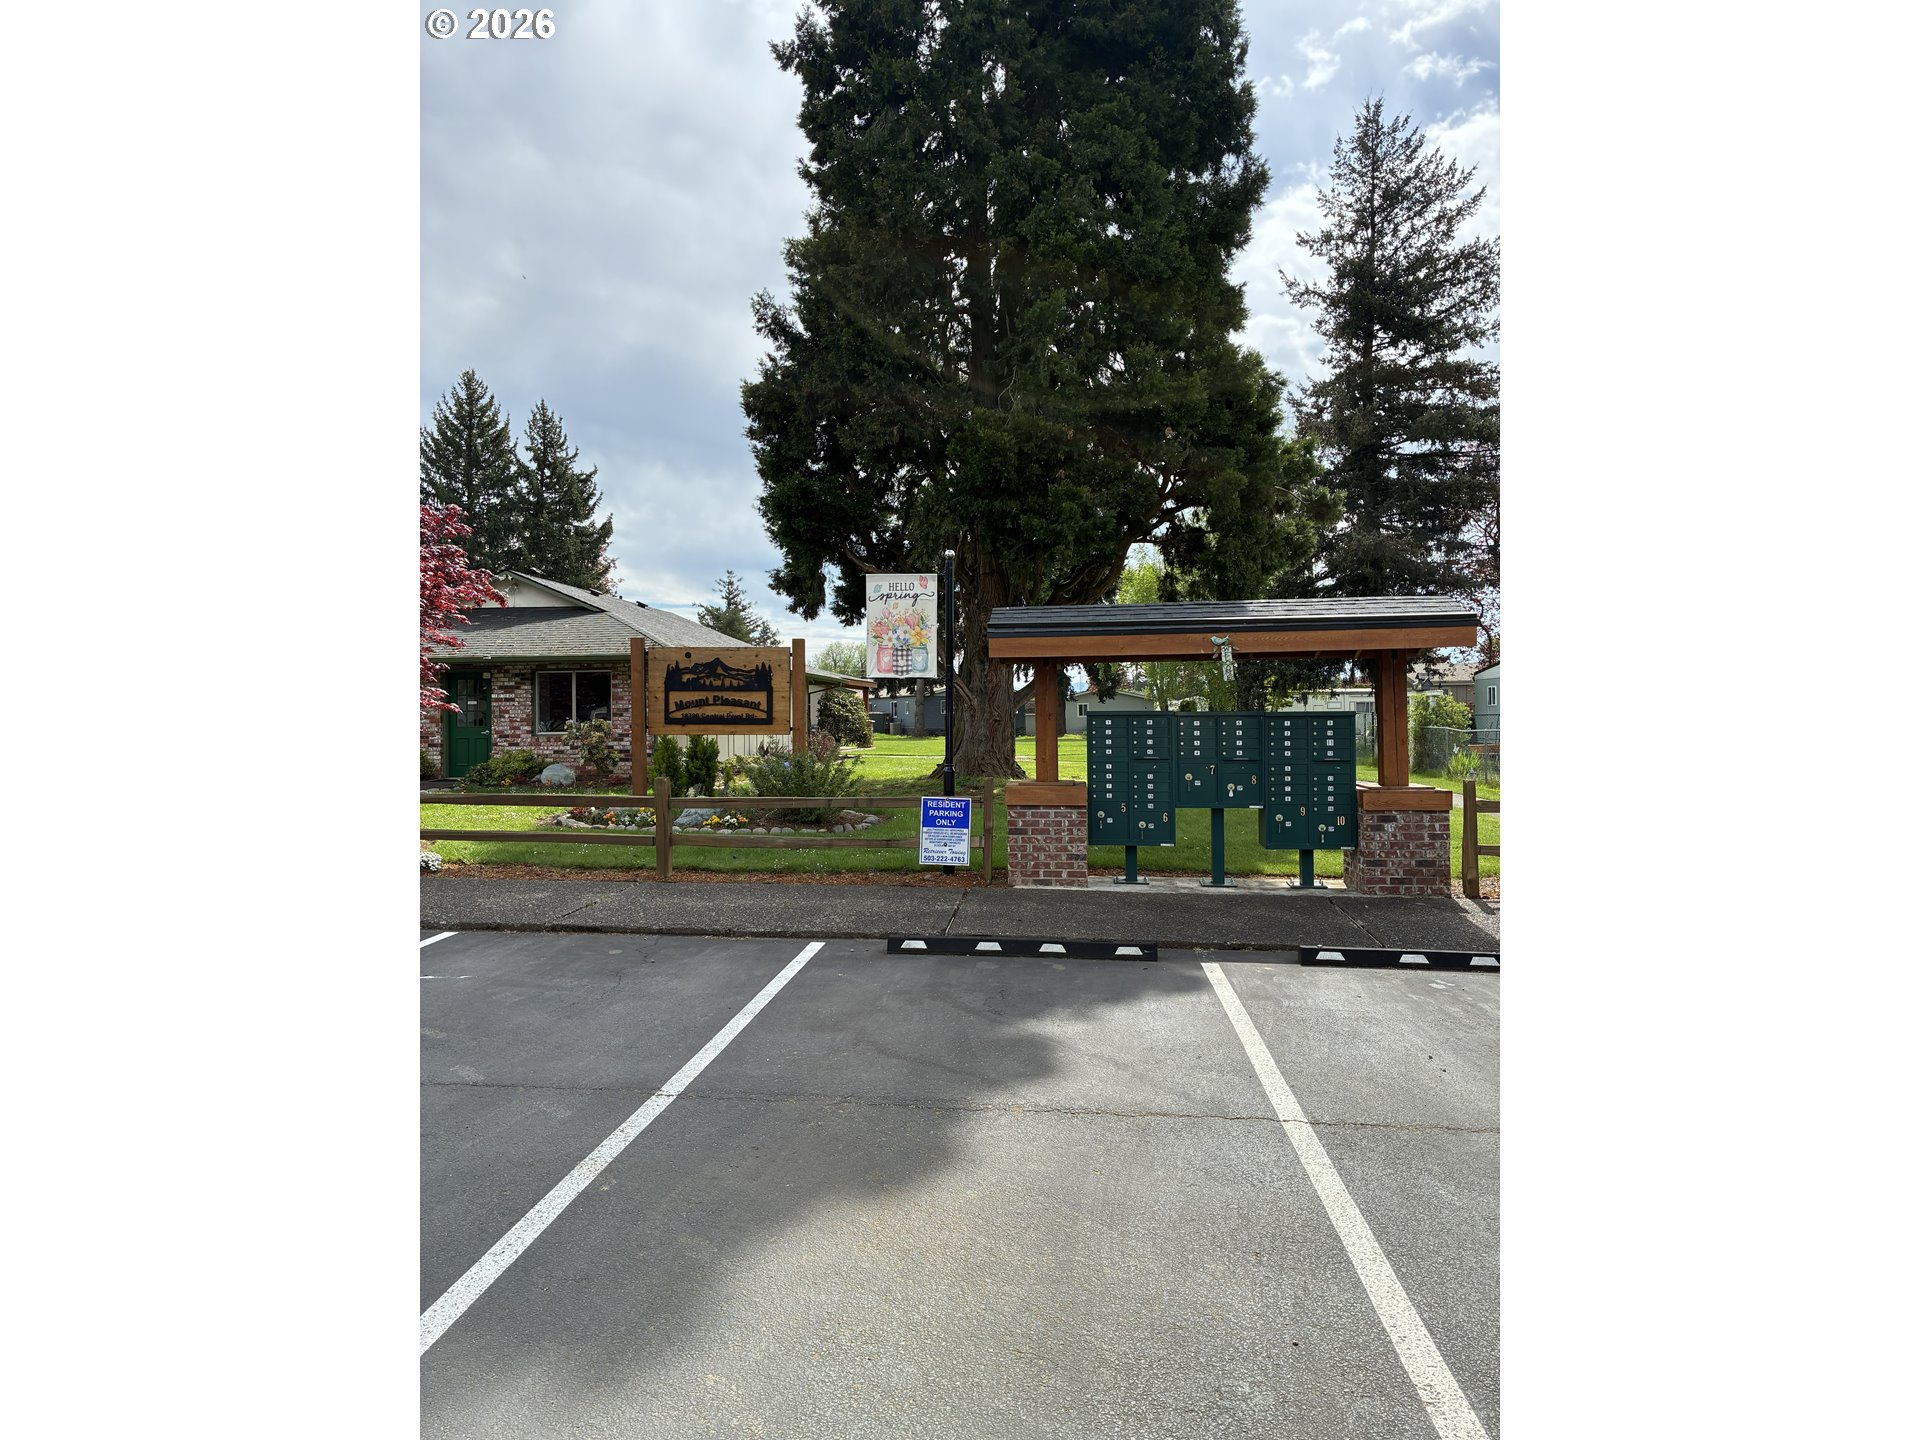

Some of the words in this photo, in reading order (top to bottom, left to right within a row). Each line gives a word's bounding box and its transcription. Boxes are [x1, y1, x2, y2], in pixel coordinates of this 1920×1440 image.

[888, 582, 915, 592] HELLO
[868, 591, 935, 607] spring
[674, 696, 709, 710] Mount
[713, 695, 762, 710] Pleasant
[1209, 765, 1216, 775] 7
[1251, 775, 1257, 785] 8
[927, 800, 966, 809] RESIDENT
[1120, 802, 1127, 812] 5
[1300, 806, 1306, 817] 9
[1162, 812, 1169, 823] 6
[1336, 815, 1346, 826] 10
[948, 848, 966, 856] Towing
[923, 855, 965, 863] 503-222-4763
